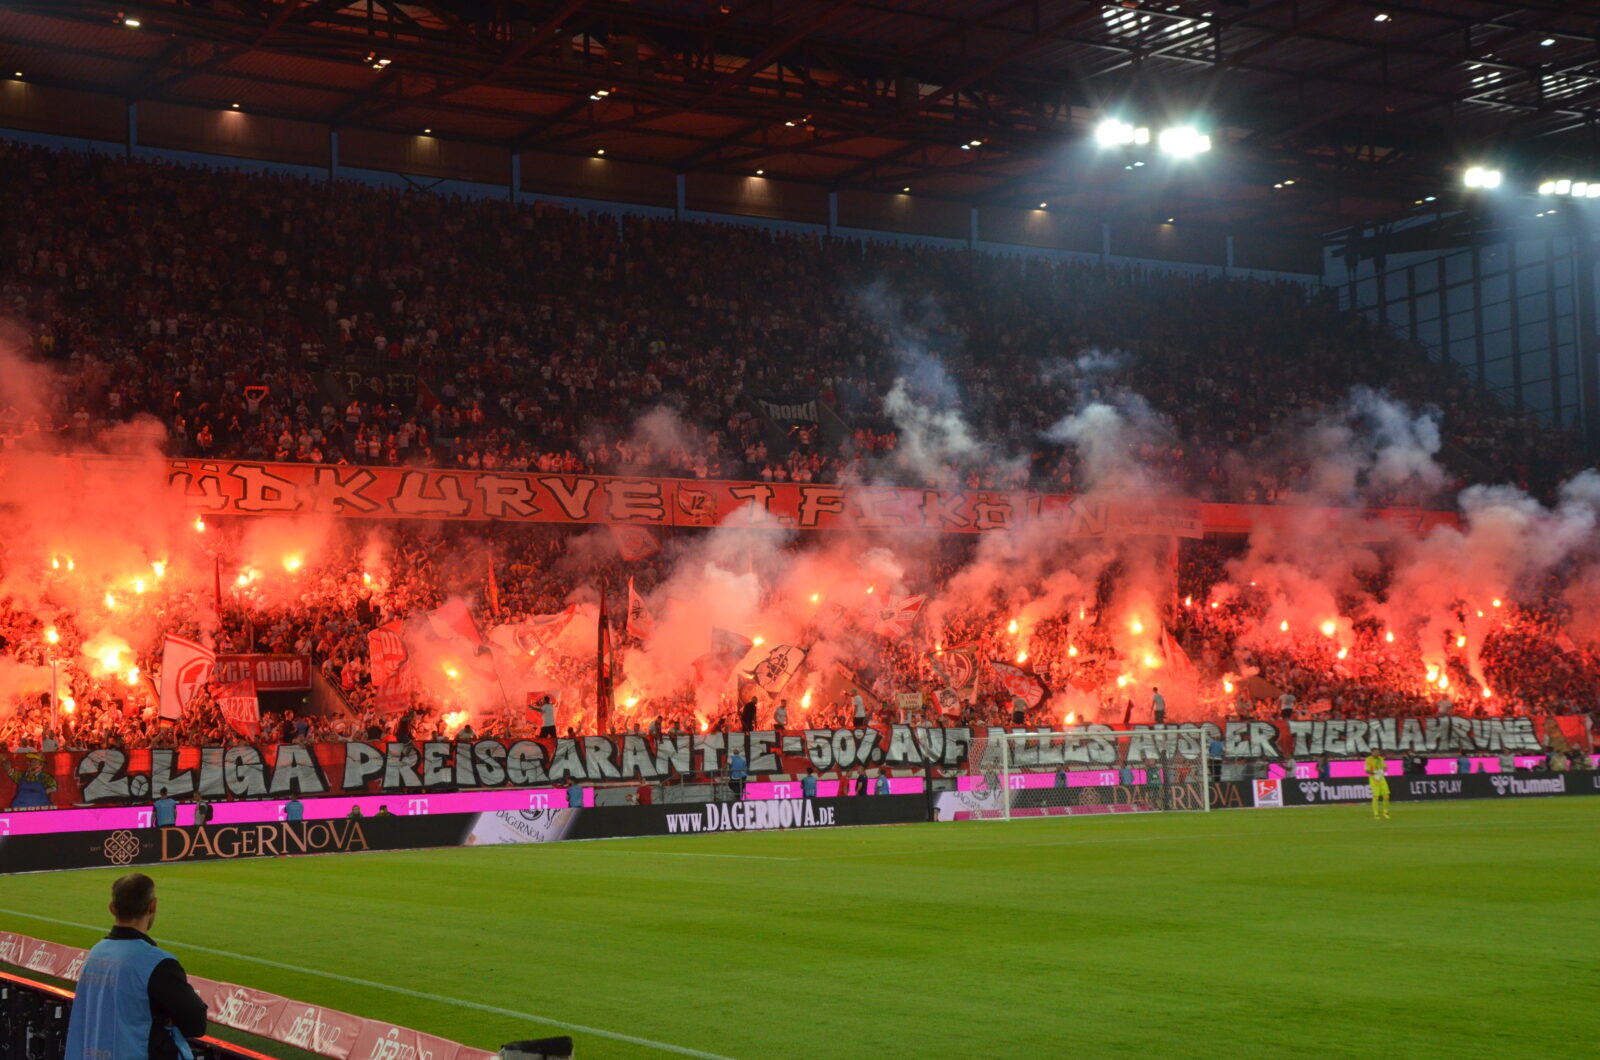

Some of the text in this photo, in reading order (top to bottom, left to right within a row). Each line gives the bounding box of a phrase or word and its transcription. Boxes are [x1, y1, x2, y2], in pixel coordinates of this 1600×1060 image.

[78, 744, 324, 802] 2.LIGA
[884, 724, 972, 766] AUF
[1321, 781, 1373, 800] humme
[1438, 780, 1462, 793] PLAY
[1511, 774, 1566, 793] hummel
[666, 799, 835, 833] WWW.DAGERNOVA.DE
